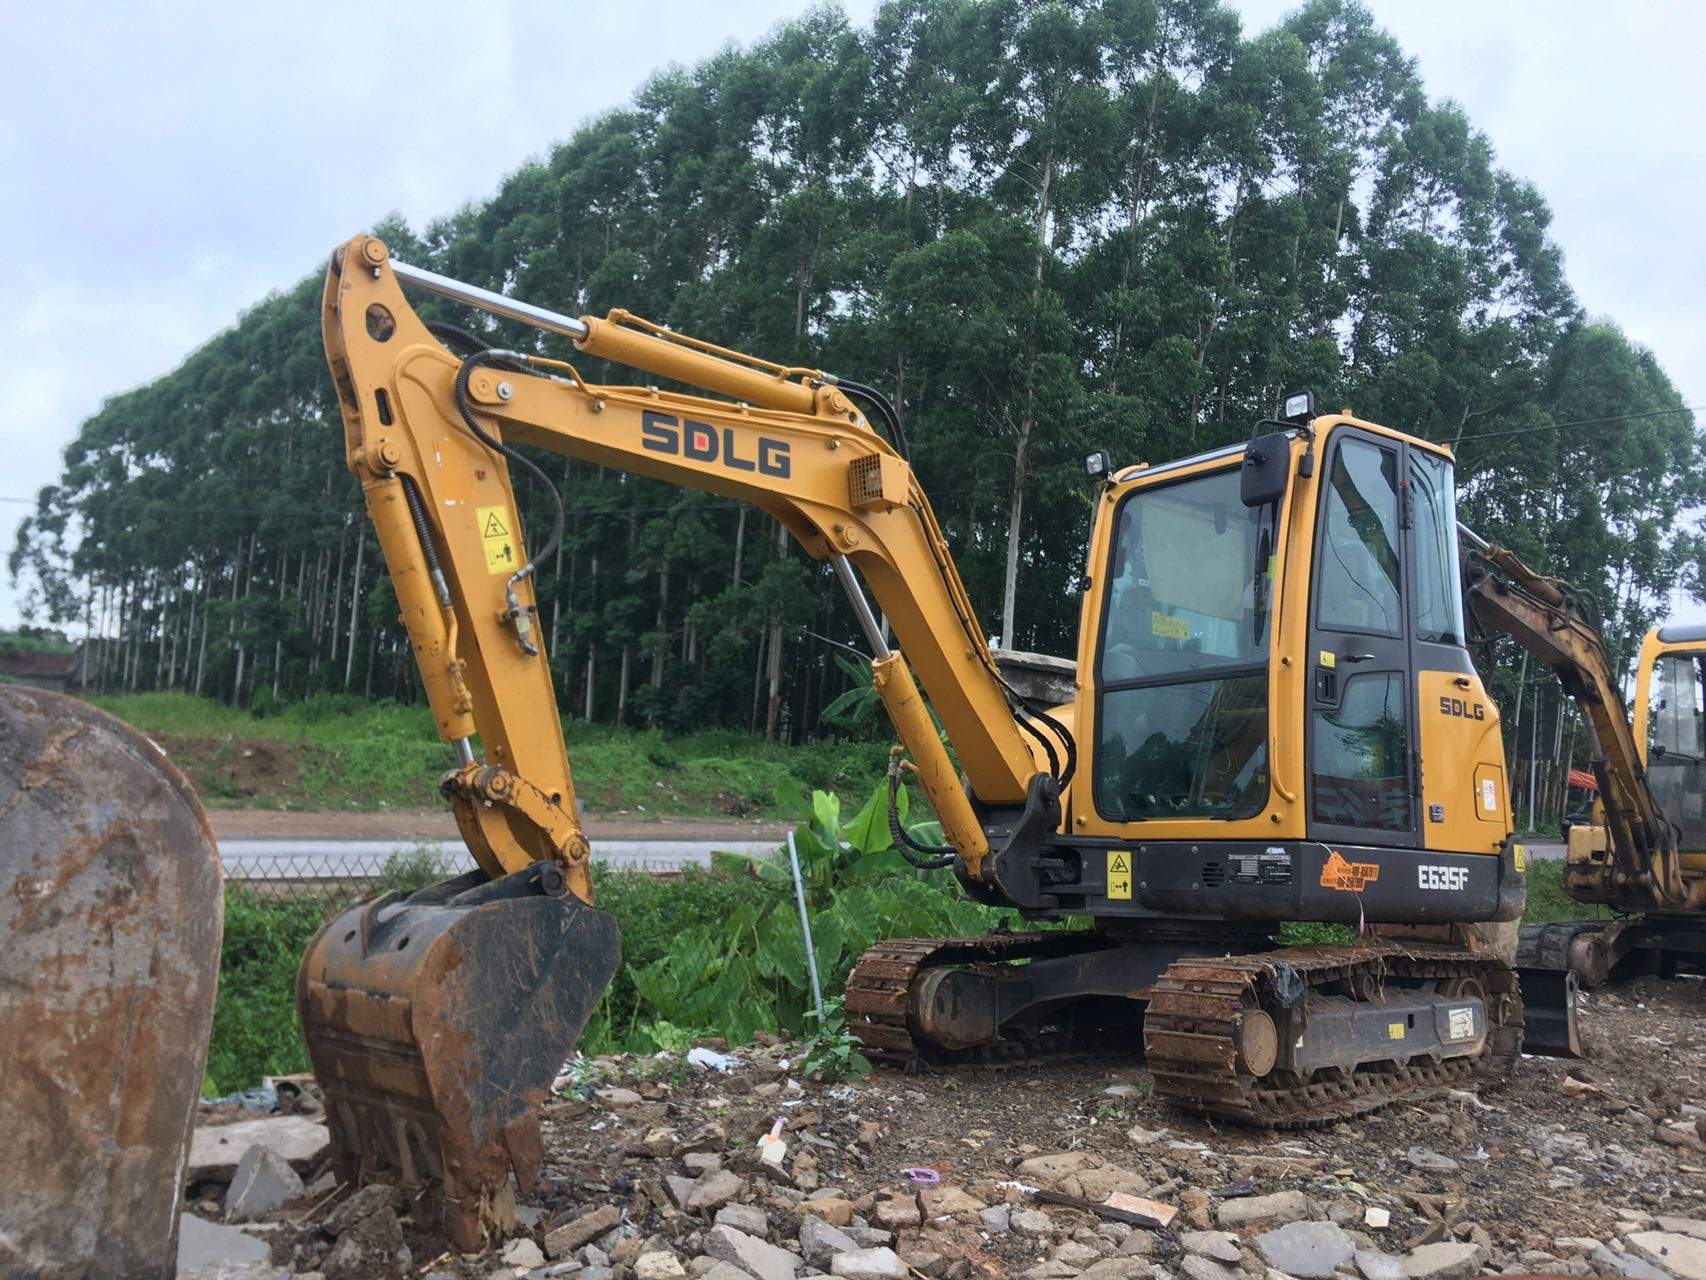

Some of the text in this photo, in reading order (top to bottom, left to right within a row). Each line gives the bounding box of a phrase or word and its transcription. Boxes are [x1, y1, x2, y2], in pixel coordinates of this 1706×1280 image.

[642, 410, 791, 479] SDLG
[1440, 696, 1484, 721] SDLG
[1418, 865, 1469, 890] E635F
